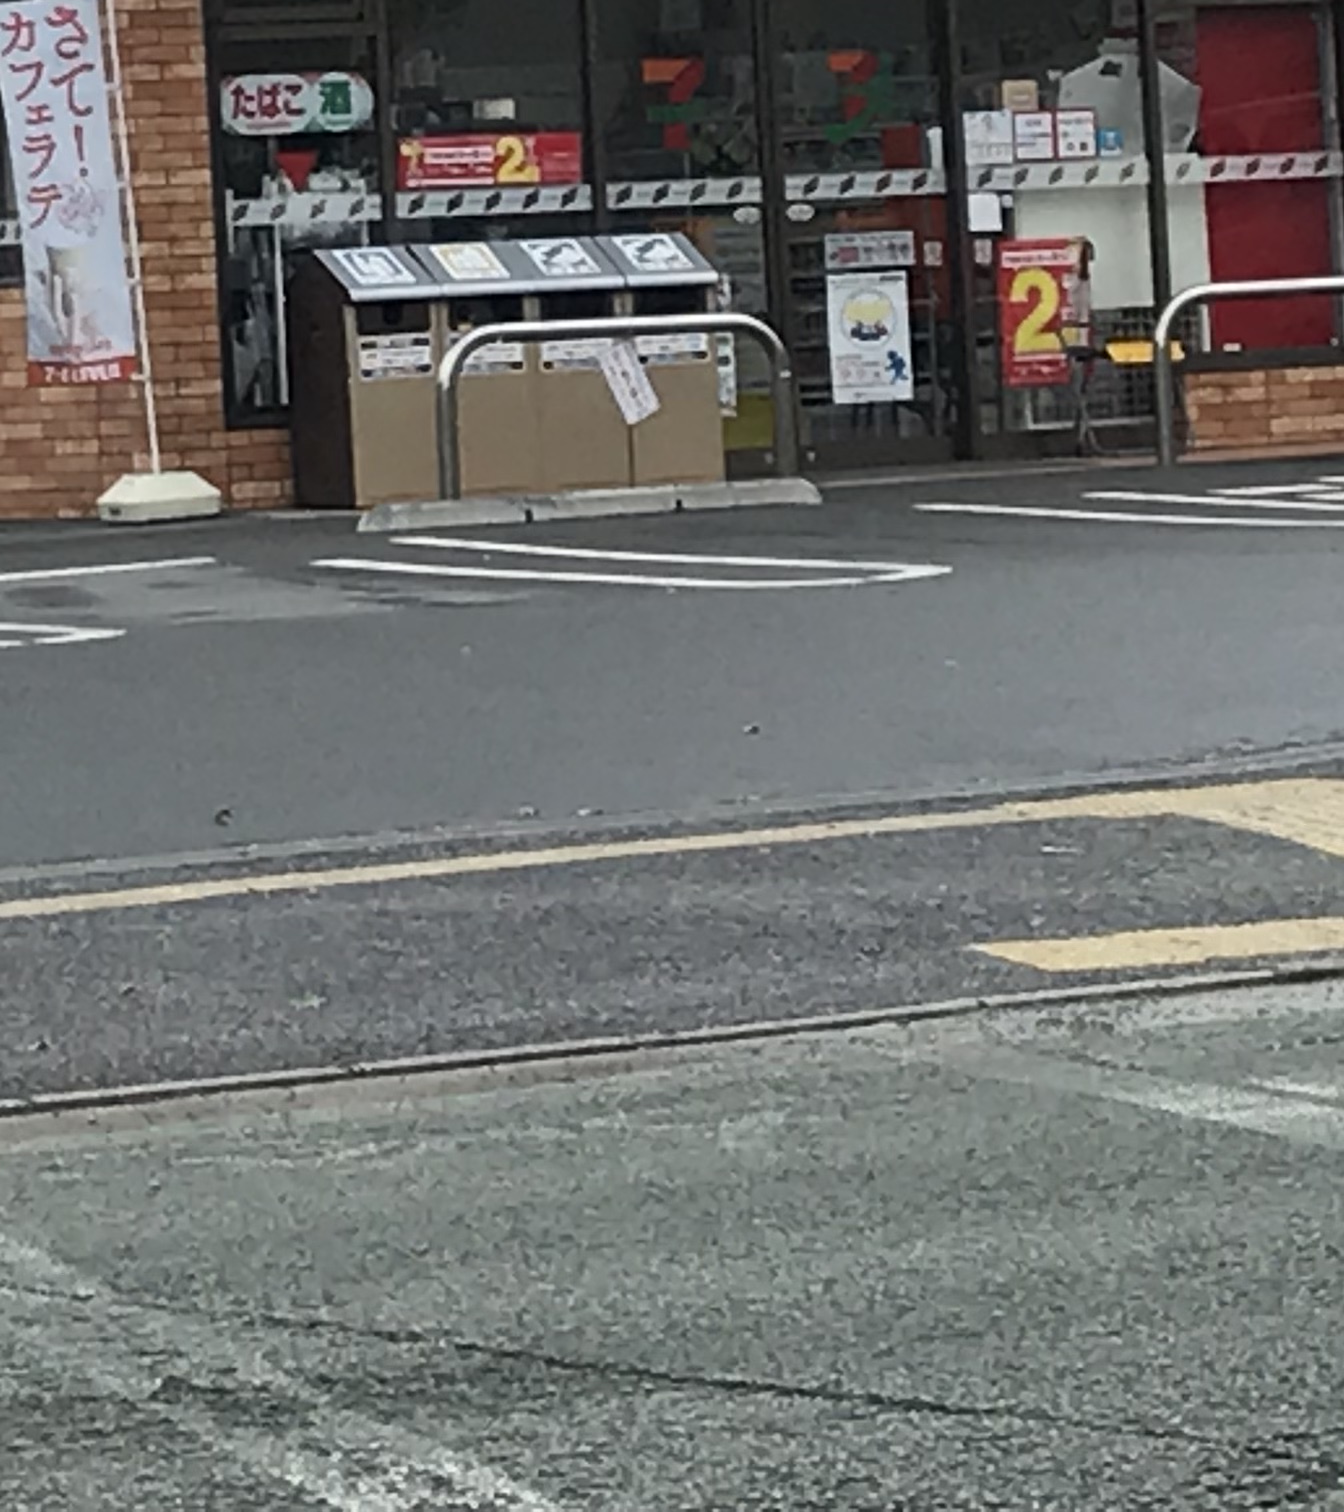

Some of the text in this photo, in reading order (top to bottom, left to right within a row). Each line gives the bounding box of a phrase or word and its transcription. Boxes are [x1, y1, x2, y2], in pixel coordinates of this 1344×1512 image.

[0, 11, 63, 230] カフェラテ
[230, 82, 306, 120] たばこ
[319, 80, 352, 115] 酒
[1009, 266, 1062, 357] 2
